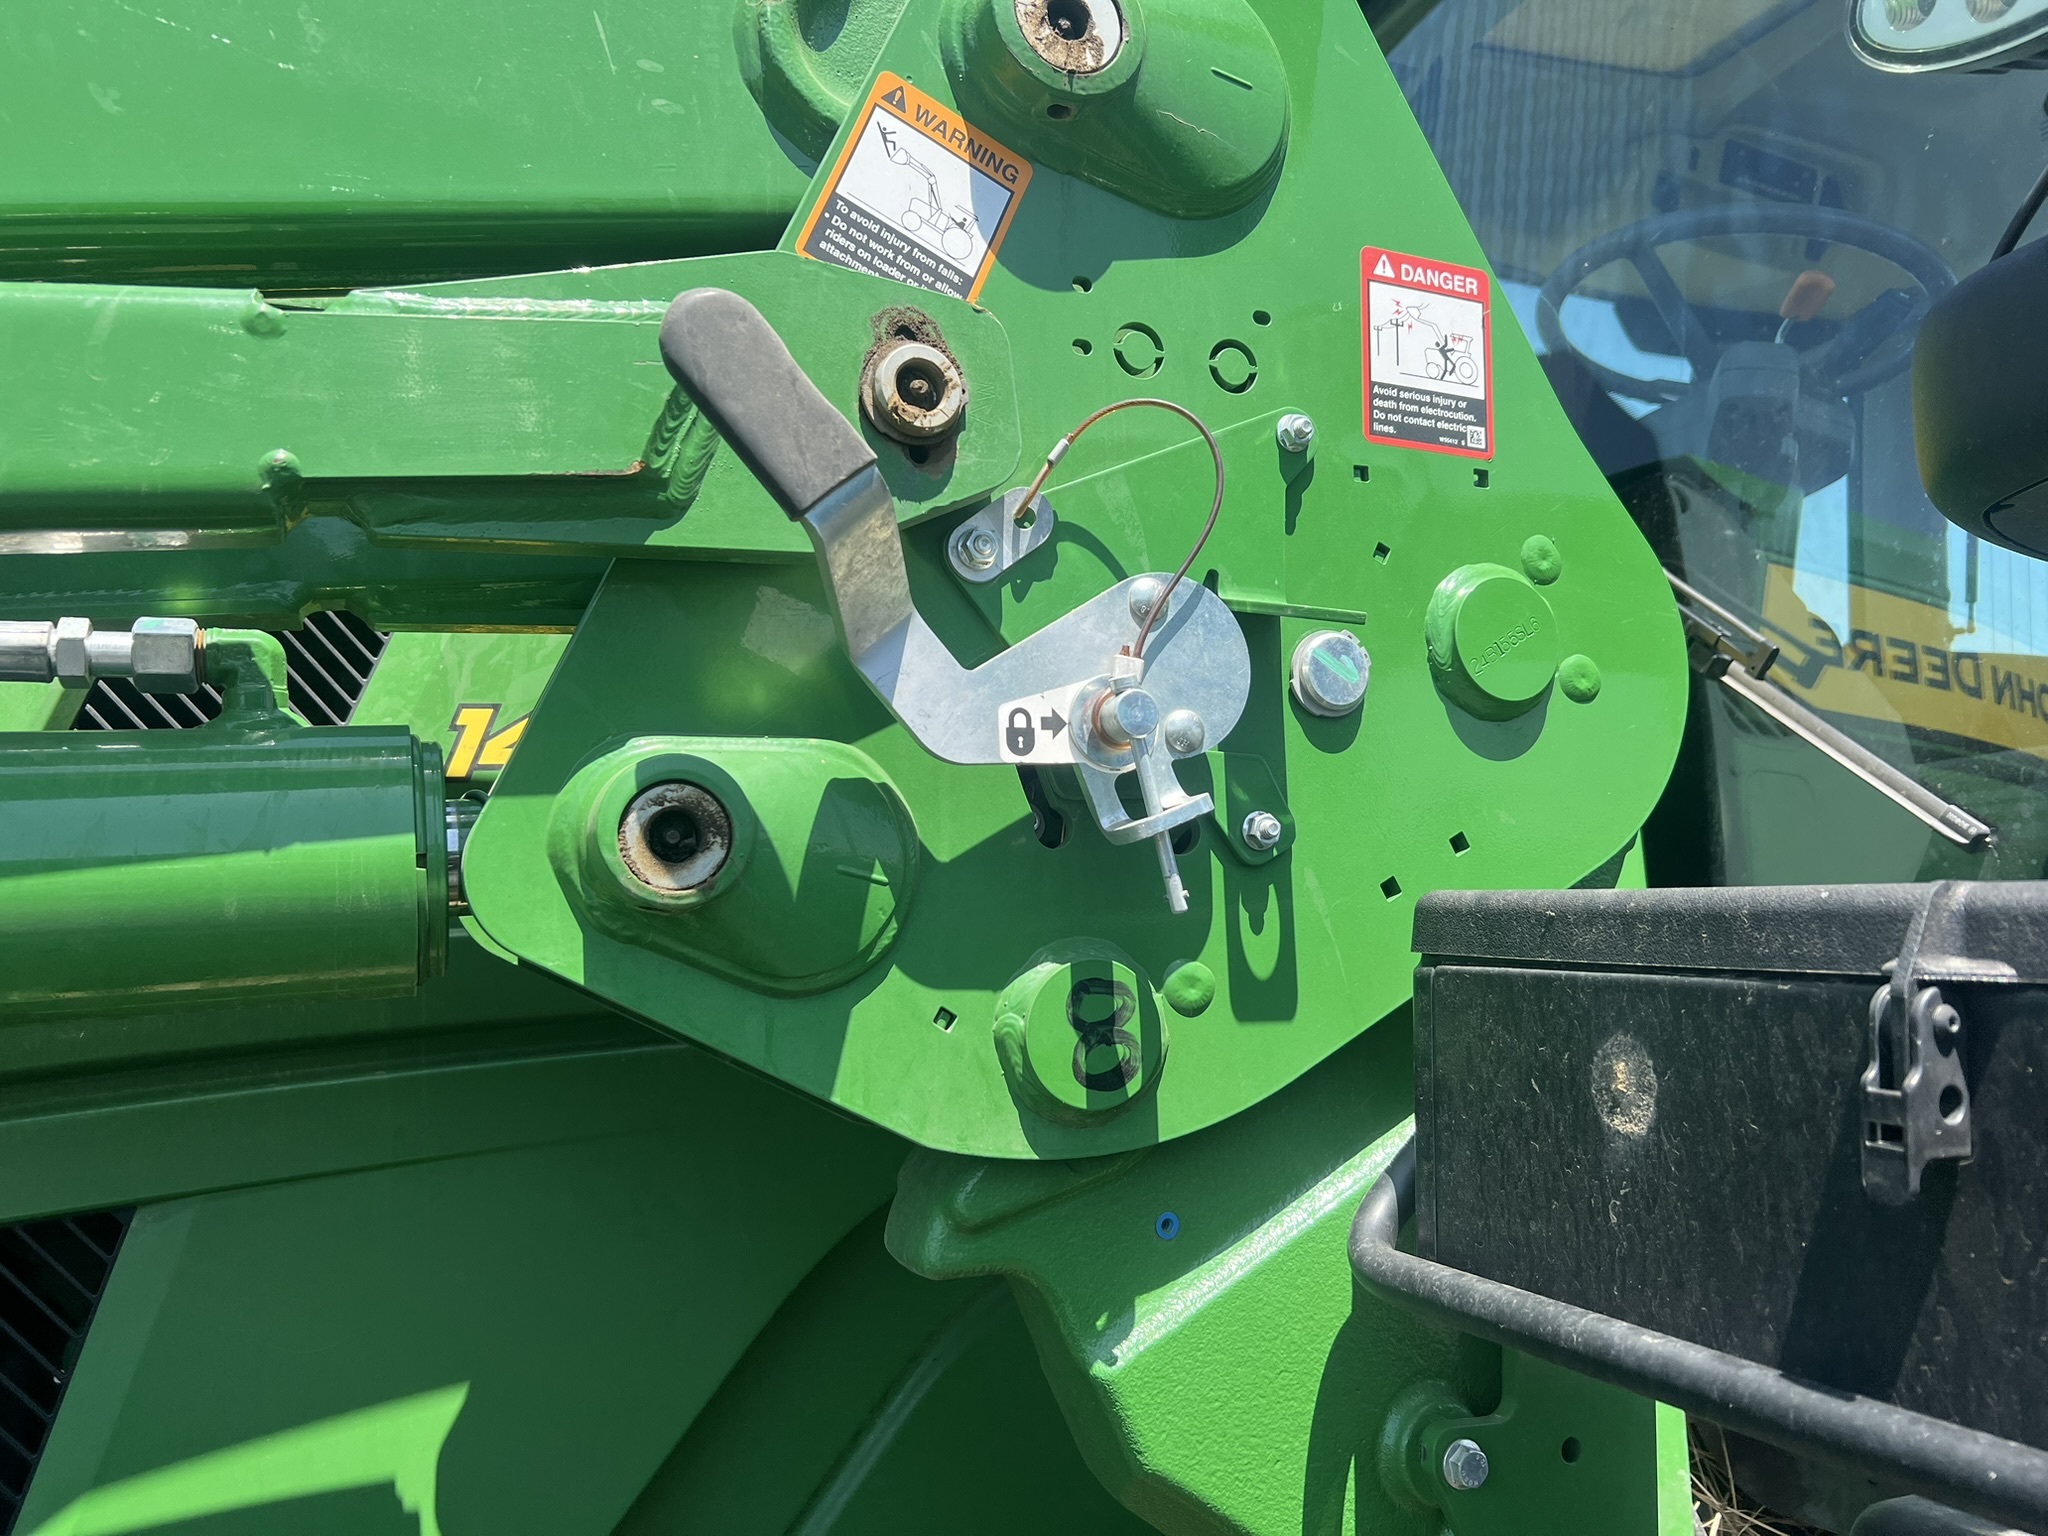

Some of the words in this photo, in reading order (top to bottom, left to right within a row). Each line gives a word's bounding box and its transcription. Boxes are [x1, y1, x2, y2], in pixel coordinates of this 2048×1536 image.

[914, 104, 1019, 185] WARNING
[825, 228, 856, 252] riders
[857, 248, 872, 262] on
[873, 256, 906, 281] loader
[831, 215, 847, 231] Do
[848, 227, 868, 244] not
[868, 239, 895, 261] work
[896, 255, 921, 276] from
[922, 272, 935, 284] or
[836, 199, 849, 214] To
[849, 211, 880, 234] avoid
[880, 227, 911, 253] injury
[912, 247, 937, 269] from
[938, 263, 963, 285] falls:
[1401, 264, 1478, 295] DANGER
[1373, 384, 1397, 397] Avoid
[1399, 390, 1431, 403] serious
[1432, 394, 1456, 409] injury
[1457, 401, 1467, 409] or
[1373, 397, 1397, 410] death
[1399, 401, 1419, 413] from
[1420, 405, 1477, 423] electrocution.
[1373, 409, 1385, 419] Do
[1387, 413, 1402, 423] not
[1403, 416, 1435, 428] contact
[1436, 420, 1467, 433] electric
[1373, 422, 1396, 434] lines.
[1066, 977, 1143, 1092] 8
